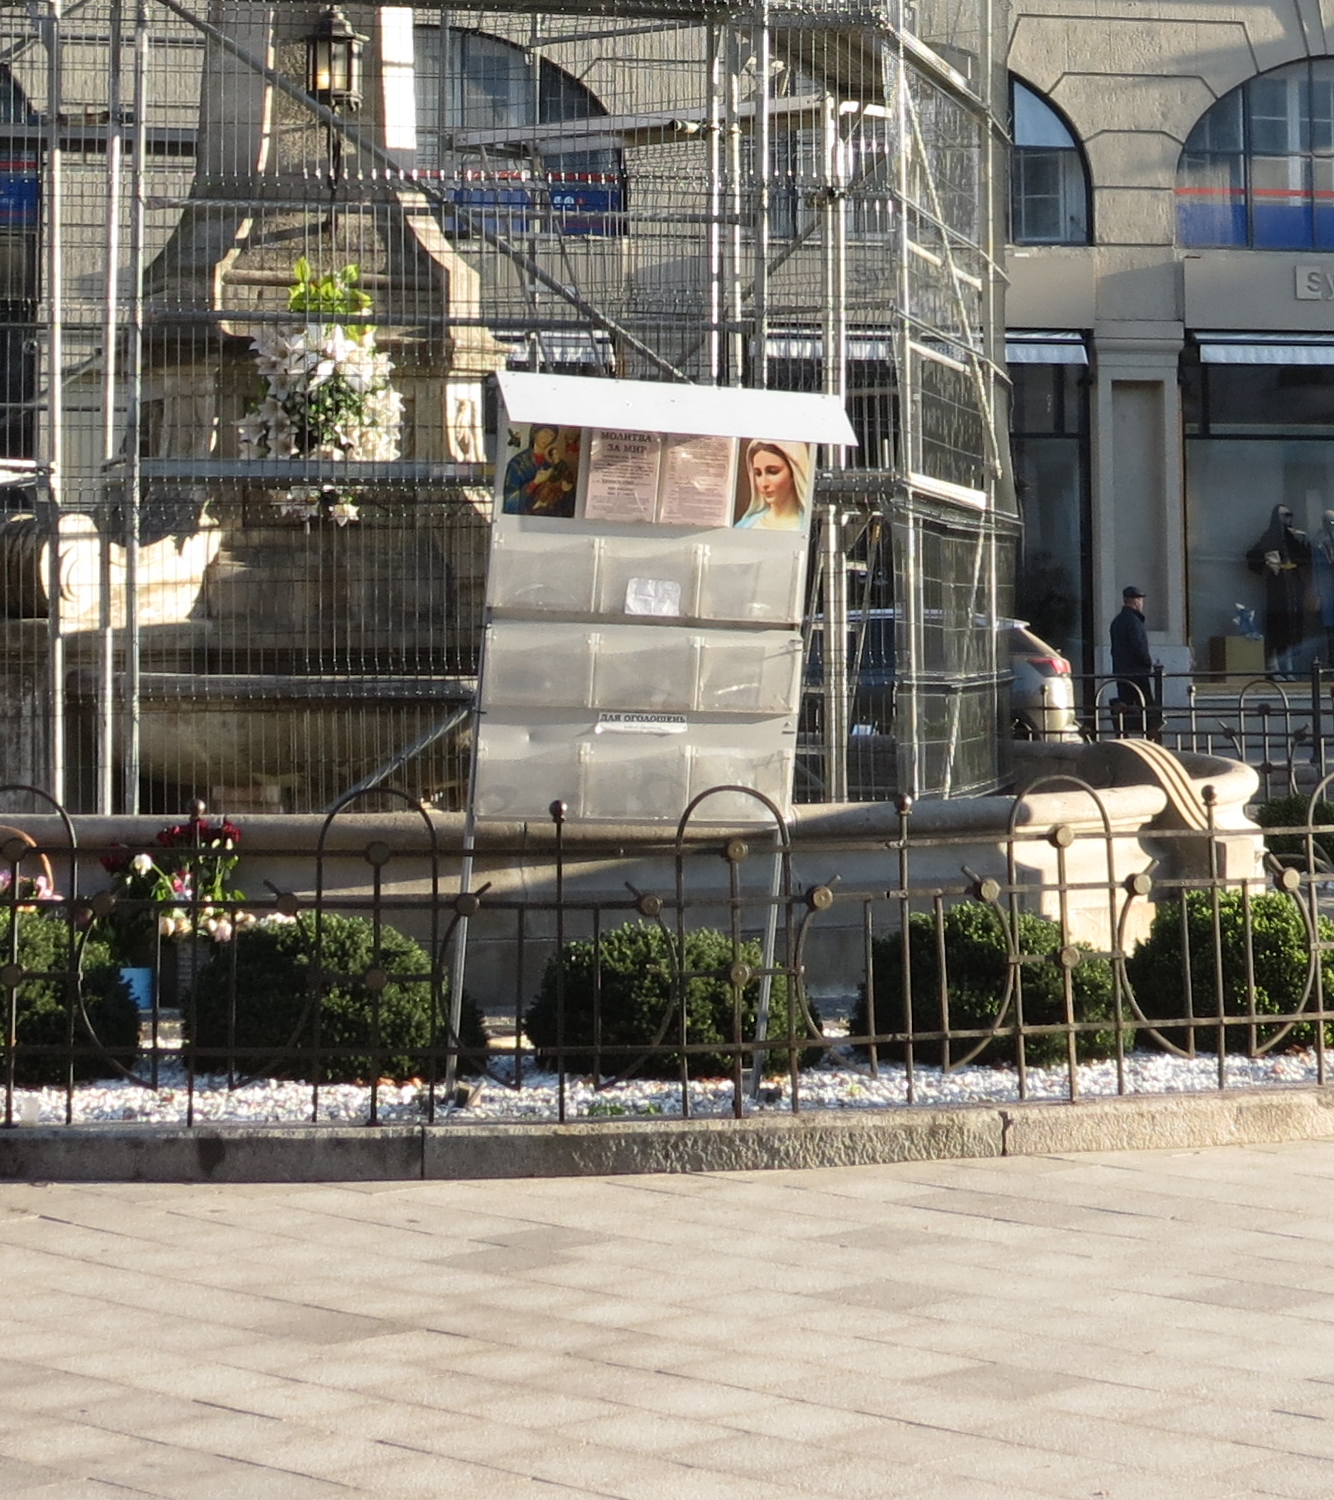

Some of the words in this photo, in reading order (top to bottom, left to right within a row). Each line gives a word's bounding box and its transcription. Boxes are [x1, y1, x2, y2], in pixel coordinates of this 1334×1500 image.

[600, 431, 653, 443] МОЛИТВА
[606, 443, 621, 452] ЗА
[600, 714, 621, 722] ДЛЯ
